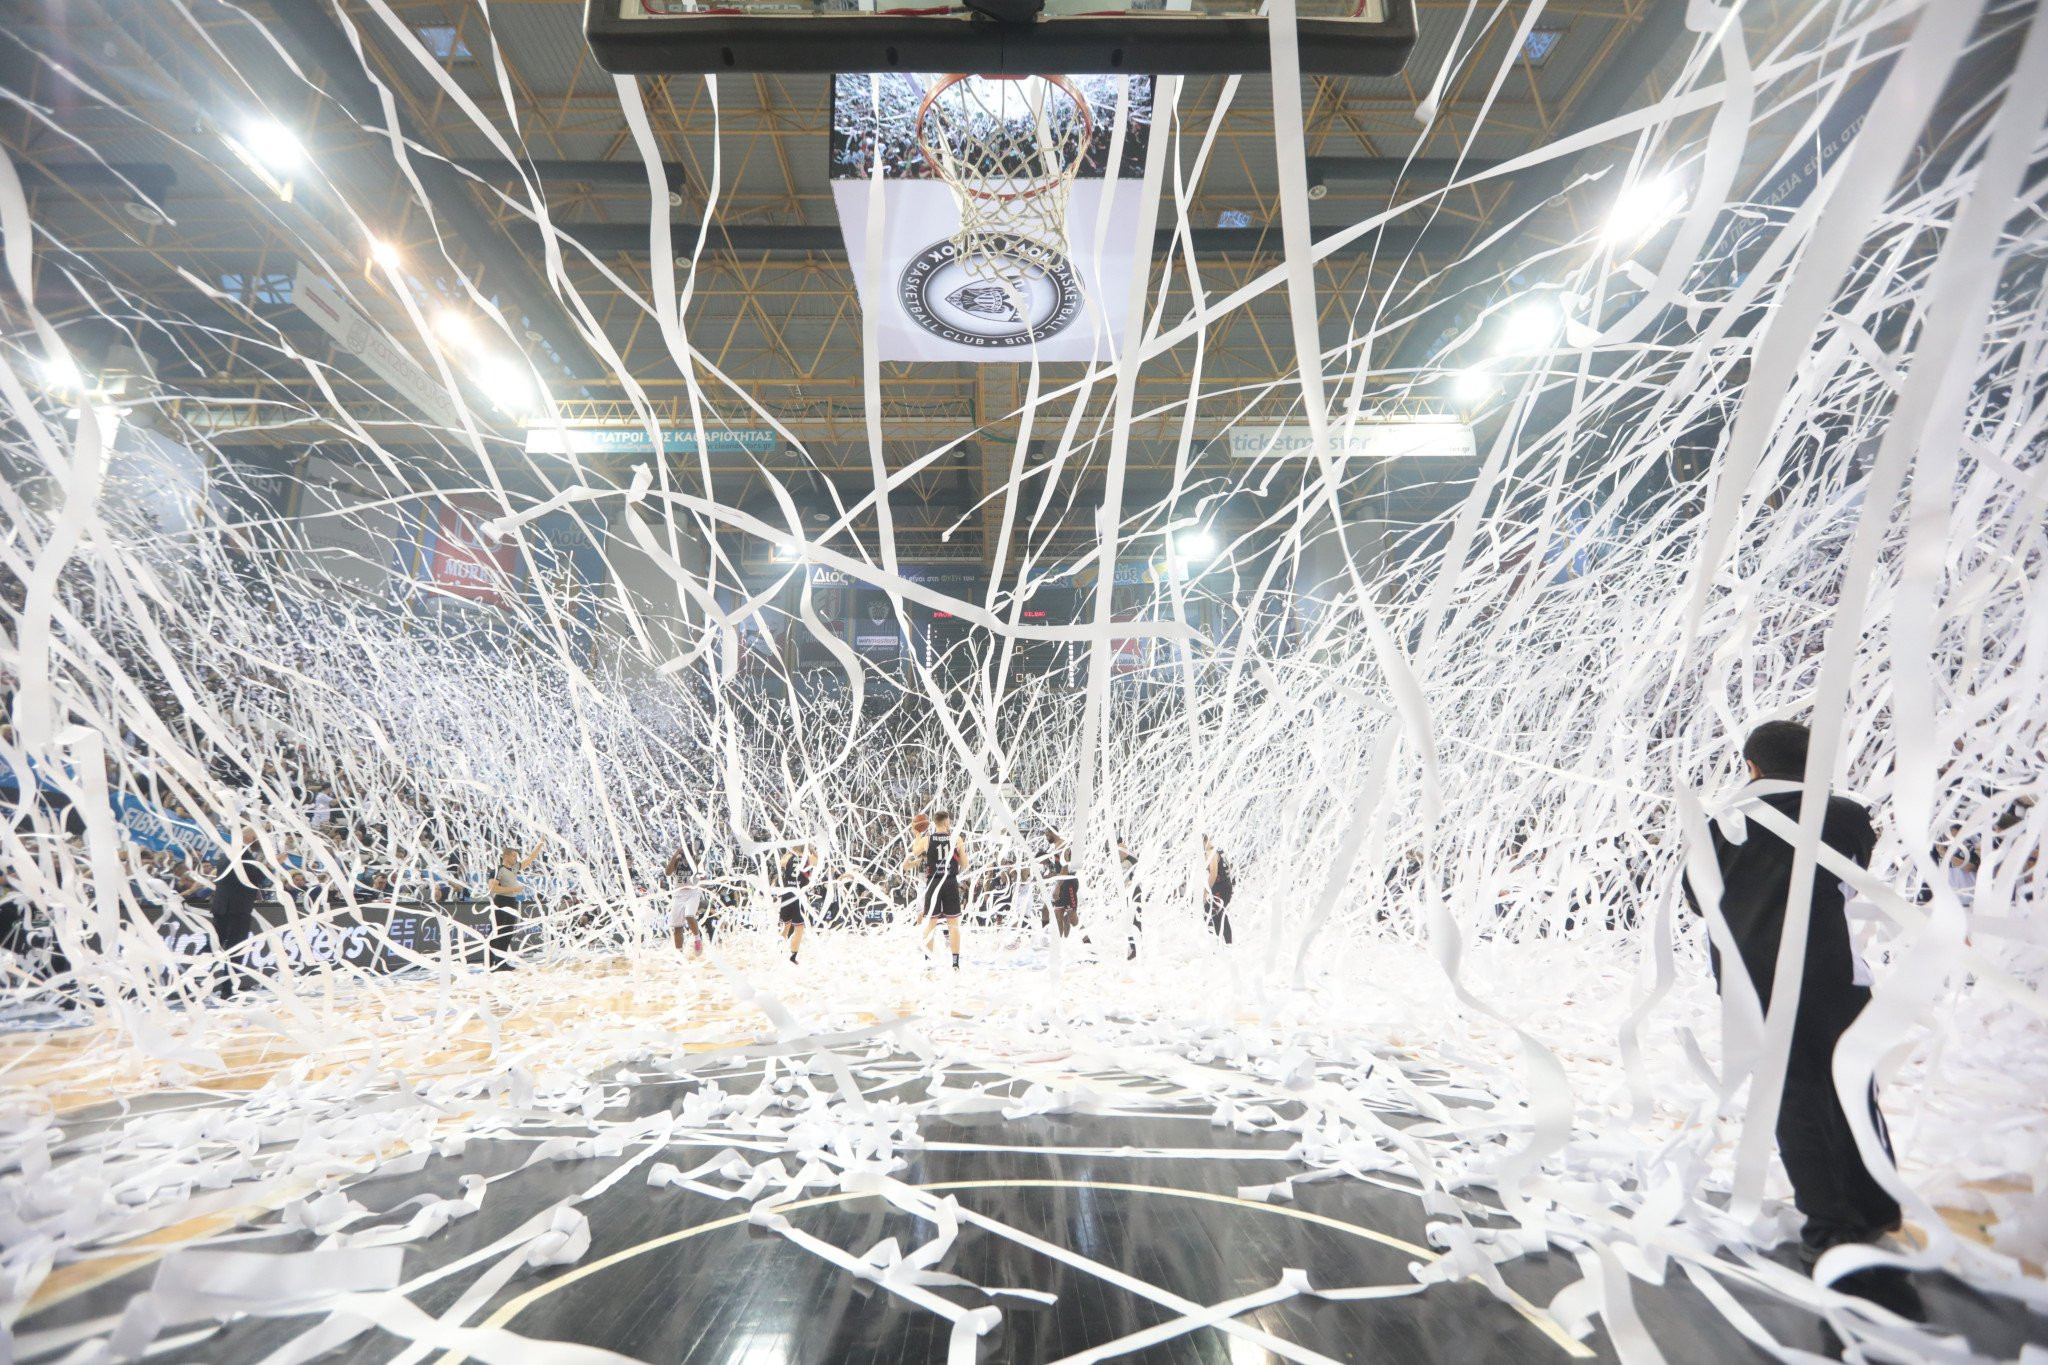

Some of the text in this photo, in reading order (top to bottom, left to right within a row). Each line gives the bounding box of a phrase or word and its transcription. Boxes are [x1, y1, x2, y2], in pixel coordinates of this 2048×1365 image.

[904, 262, 939, 332] BASKETBALL
[942, 330, 985, 345] CLUB
[1044, 263, 1076, 332] BASKETBALL
[1005, 331, 1045, 345] CLUB
[1233, 432, 1373, 451] ticketmster
[936, 844, 950, 861] 11
